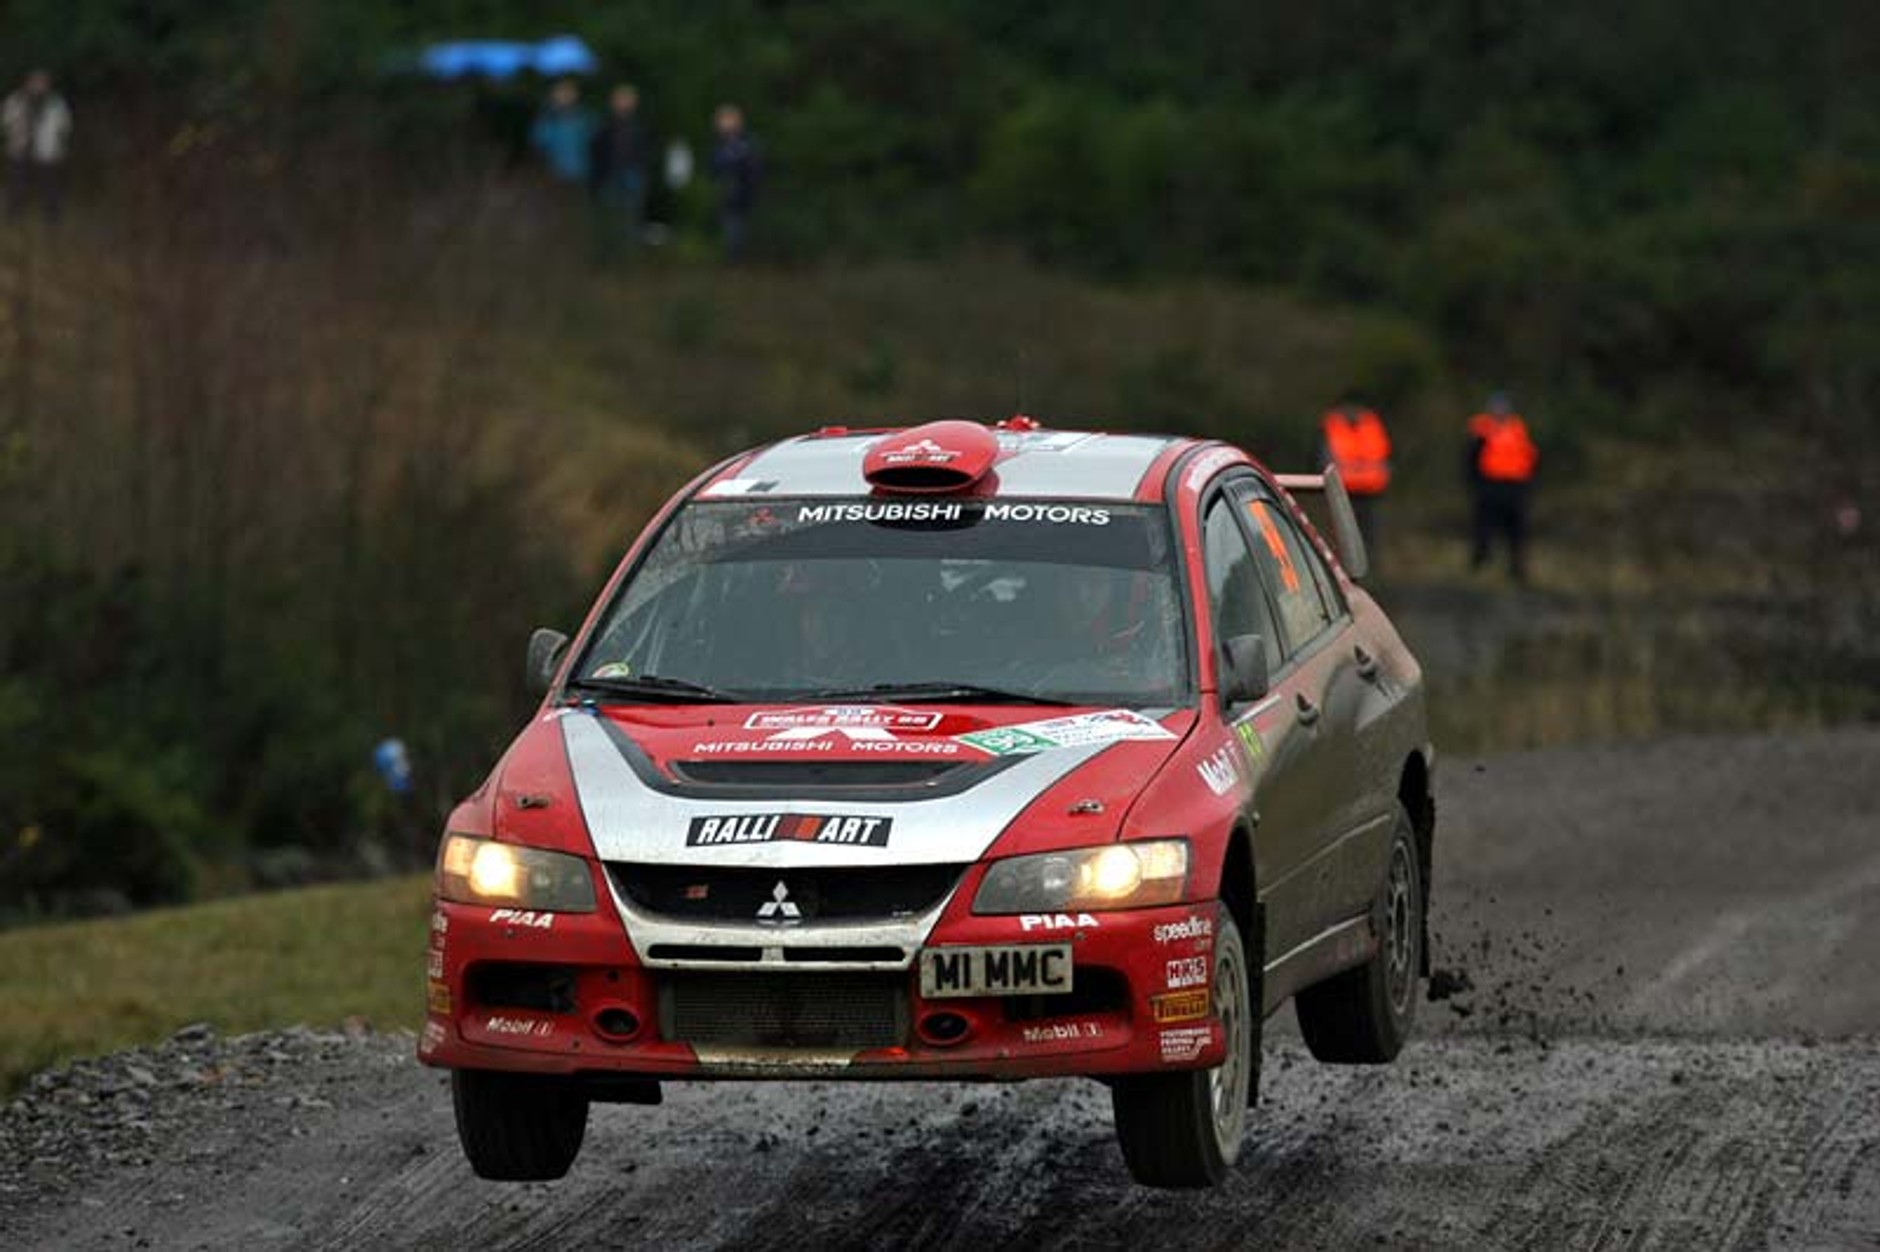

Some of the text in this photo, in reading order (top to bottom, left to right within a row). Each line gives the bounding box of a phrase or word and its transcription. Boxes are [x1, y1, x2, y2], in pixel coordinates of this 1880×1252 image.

[798, 503, 1111, 526] MITSUBISHI MOTORS
[694, 740, 959, 755] MITSUBISHI MOTORS
[696, 816, 882, 844] RALLI ART
[489, 909, 554, 929] PIAA
[1019, 914, 1100, 931] PIAA
[933, 949, 1064, 990] M1 MMC
[485, 1016, 534, 1035] Mobil
[1023, 1023, 1080, 1043] Mobil
